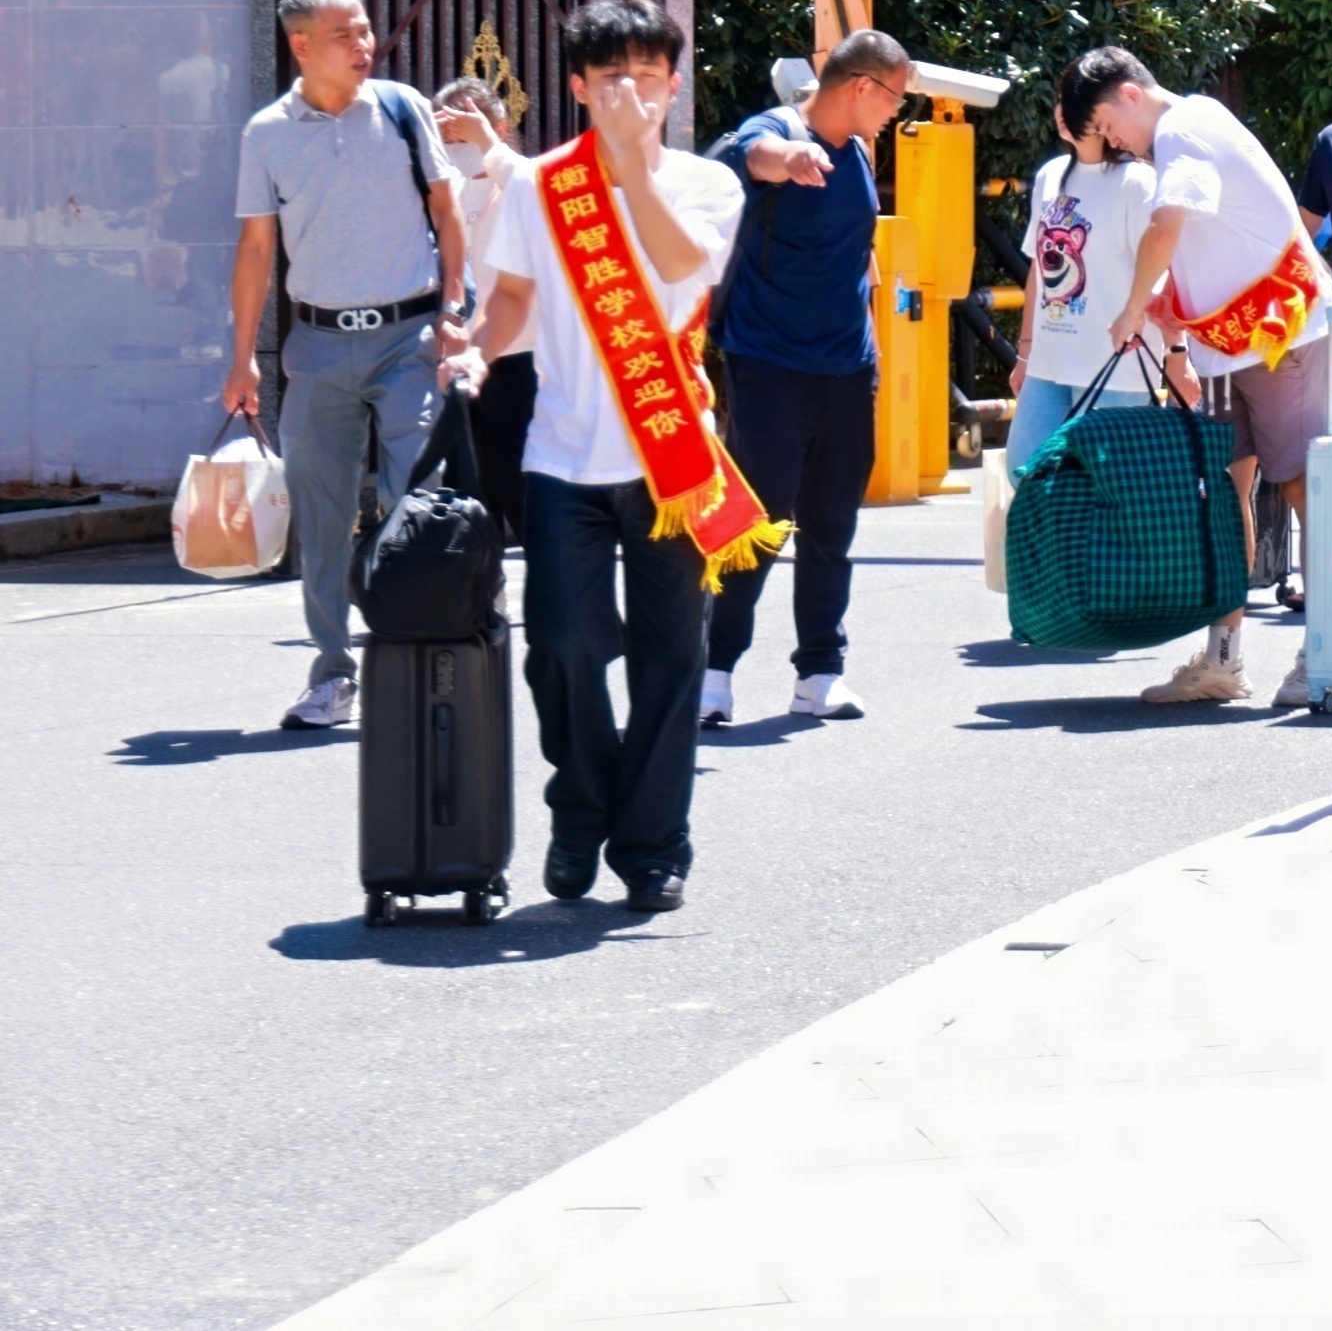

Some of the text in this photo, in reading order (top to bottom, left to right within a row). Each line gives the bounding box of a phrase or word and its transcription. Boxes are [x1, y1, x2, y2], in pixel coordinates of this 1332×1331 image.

[550, 164, 688, 441] 衡阳智胜学校欢迎你
